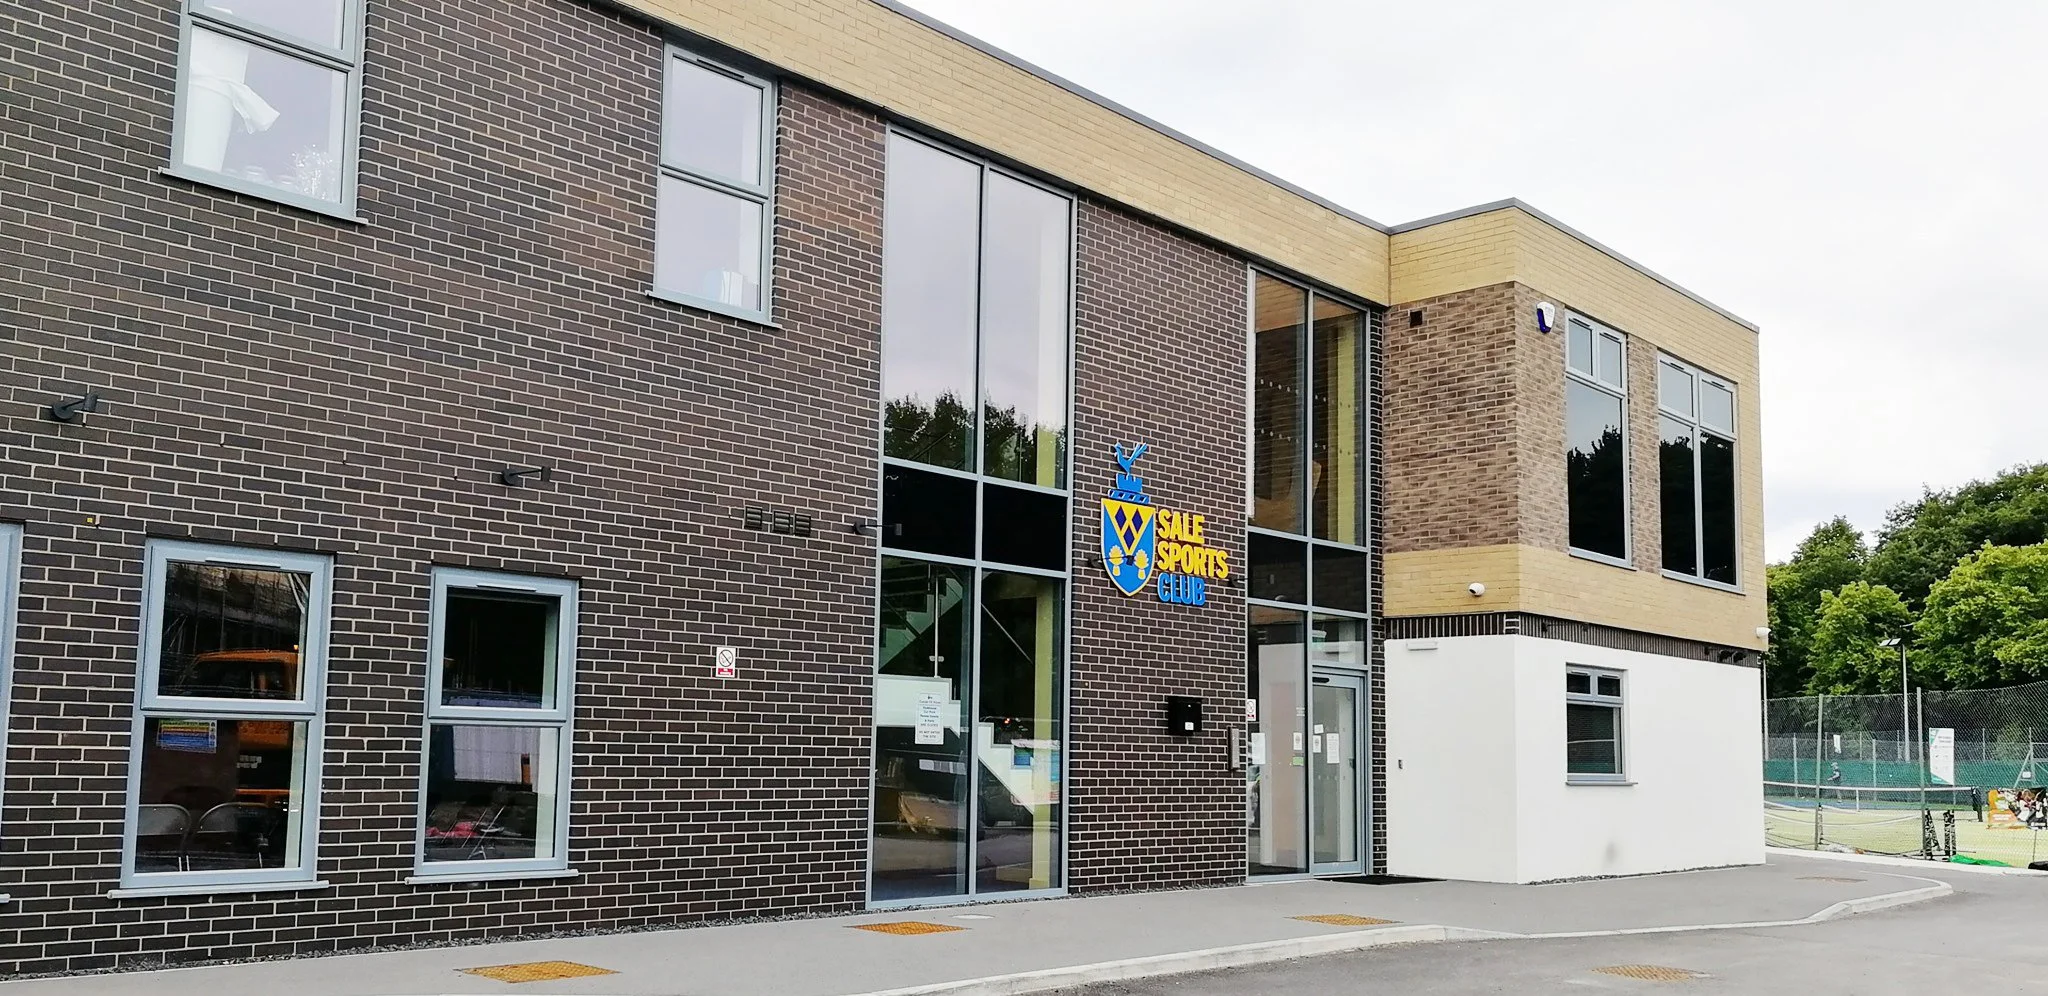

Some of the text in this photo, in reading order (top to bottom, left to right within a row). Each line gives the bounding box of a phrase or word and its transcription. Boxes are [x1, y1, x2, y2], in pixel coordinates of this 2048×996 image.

[1158, 509, 1205, 544] SALE
[1157, 541, 1229, 579] SPORTS
[1157, 572, 1206, 605] CLUB
